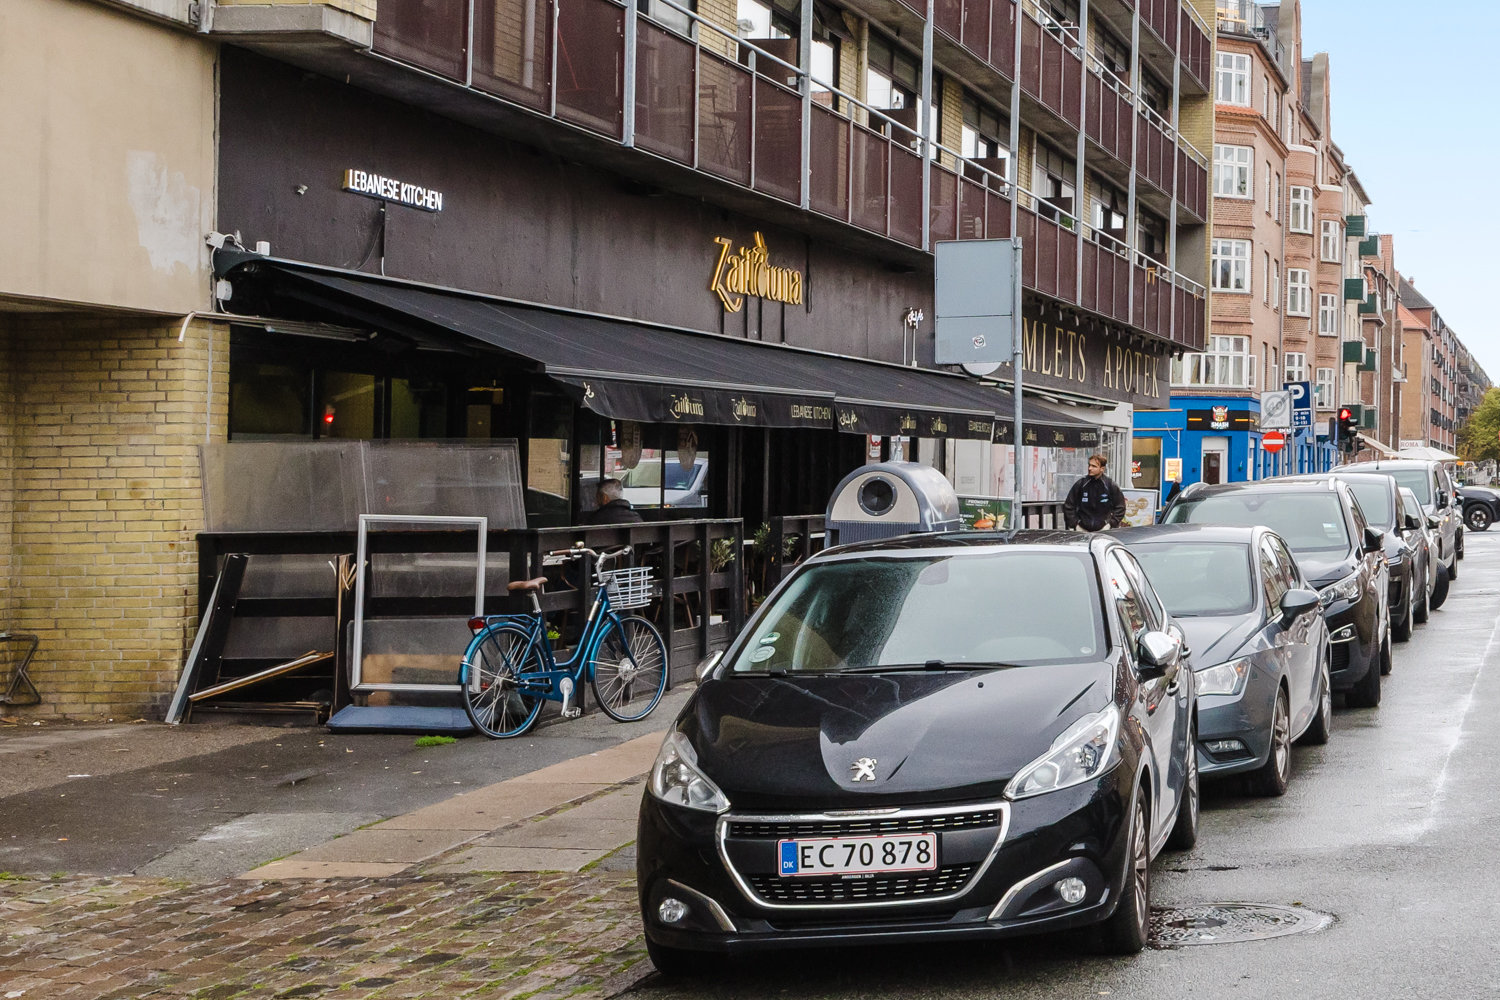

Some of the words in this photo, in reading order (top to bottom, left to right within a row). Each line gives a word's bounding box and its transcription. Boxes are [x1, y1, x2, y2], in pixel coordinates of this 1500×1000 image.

[348, 168, 400, 200] LEBANESE
[400, 182, 443, 211] KITCHEN
[1005, 317, 1086, 383] MLETS
[1103, 343, 1160, 399] APOTEK
[1289, 384, 1305, 400] P
[801, 845, 835, 869] EC
[843, 842, 874, 867] 70
[882, 840, 931, 866] 878
